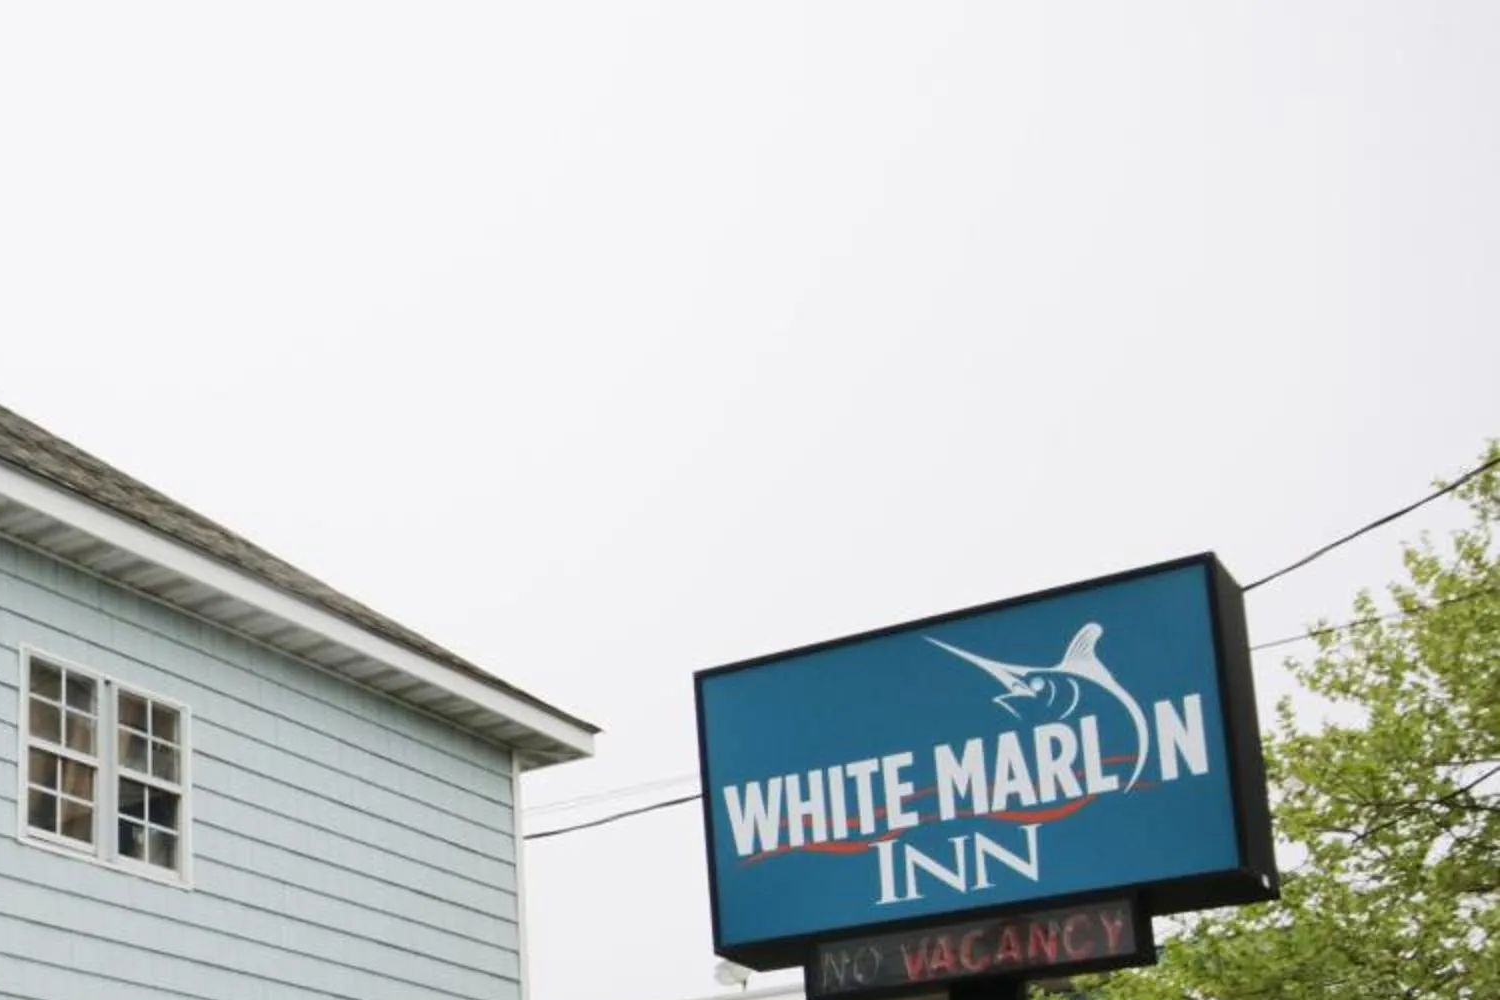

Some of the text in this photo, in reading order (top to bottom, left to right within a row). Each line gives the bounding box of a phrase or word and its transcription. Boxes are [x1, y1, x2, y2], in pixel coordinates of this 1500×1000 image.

[723, 751, 920, 857] WHITE
[867, 823, 1043, 905] INN
[821, 910, 1124, 993] NO VACANCY
